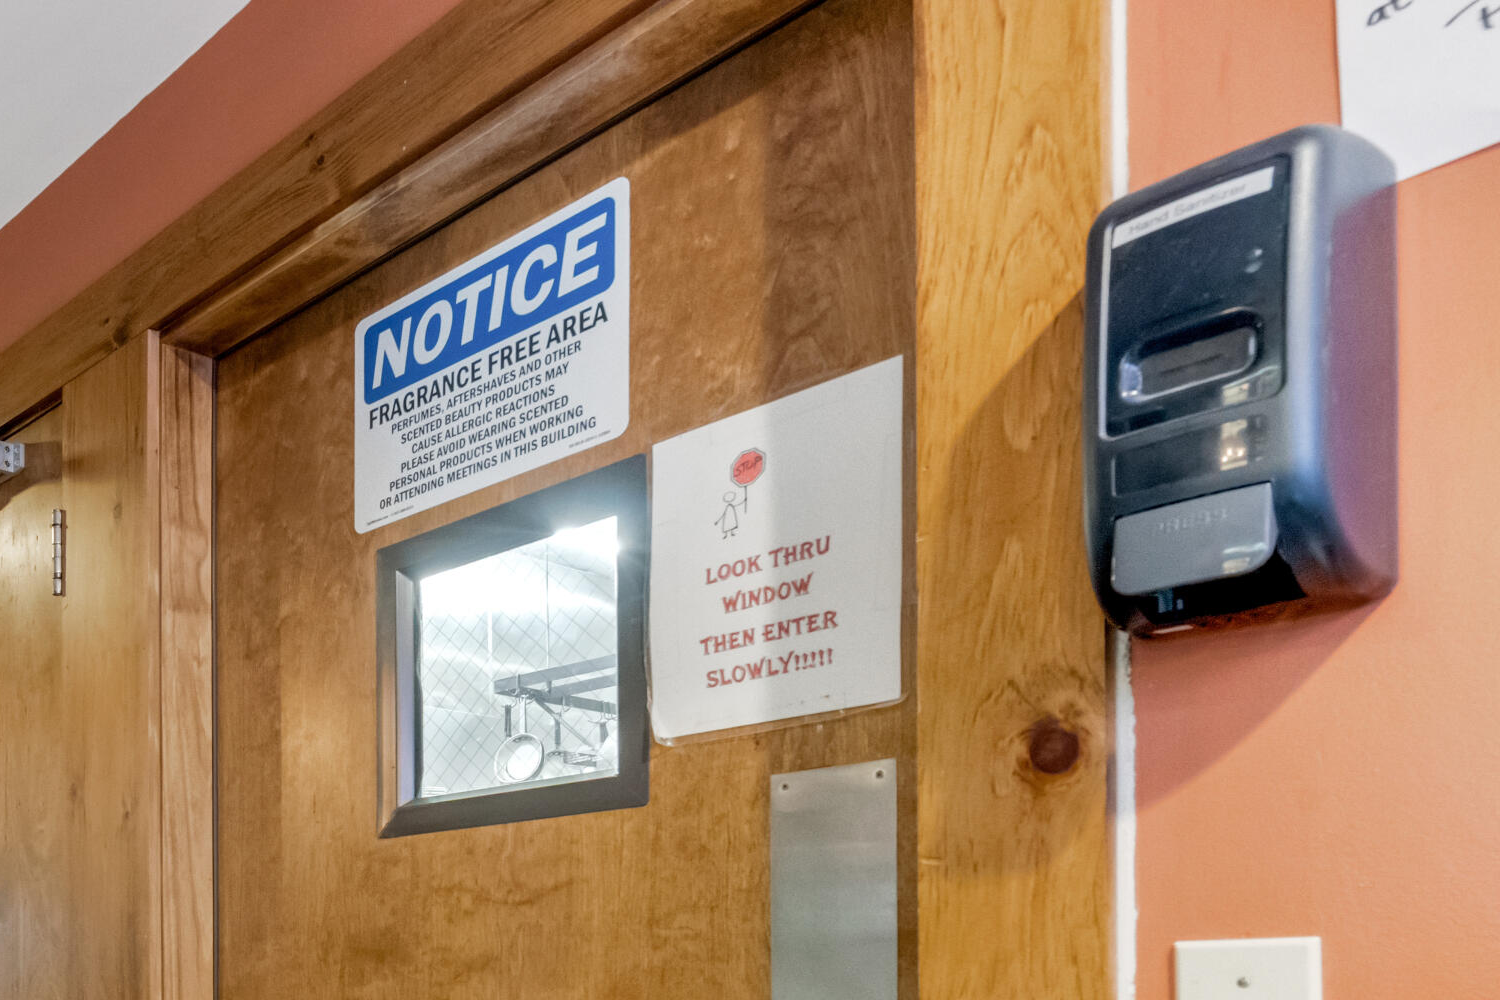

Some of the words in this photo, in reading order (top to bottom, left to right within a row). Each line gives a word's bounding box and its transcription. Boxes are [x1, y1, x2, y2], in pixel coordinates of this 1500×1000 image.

[1129, 211, 1170, 234] Hand
[371, 211, 608, 390] NOTICE
[368, 358, 483, 430] FRAGRANCE
[488, 330, 542, 376] FREE
[545, 300, 609, 350] AREA
[391, 403, 445, 435] PERFUMES,
[446, 369, 517, 411] AFTERSHAVES
[518, 358, 542, 378] AND
[544, 340, 582, 366] OTHER
[400, 418, 443, 445] SCENTED
[444, 399, 483, 426] BEAUTY
[485, 374, 543, 408] PRODUCTS
[544, 360, 570, 382] MAY
[401, 450, 435, 473] PLEASE
[437, 437, 466, 458] AVOID
[468, 417, 517, 445] WEARING
[519, 394, 569, 425] SCENTED
[411, 432, 443, 454] CAUSE
[444, 411, 493, 441] ALLERGIC
[495, 384, 556, 419] REACTIONS
[379, 496, 392, 510] OR
[393, 476, 444, 505] ATTENDING
[446, 455, 498, 484] MEETINGS
[500, 449, 512, 463] IN
[514, 439, 538, 458] THIS
[541, 416, 597, 448] BUILDING
[389, 464, 438, 492] PERSONAL
[439, 441, 493, 472] PRODUCTS
[495, 427, 527, 449] WHEN
[529, 404, 584, 436] WORKING
[733, 455, 764, 478] STOP
[704, 553, 763, 586] LOOK
[768, 535, 831, 566] THRU
[721, 572, 814, 614] WINDOW
[699, 627, 756, 656] THEN
[761, 610, 839, 643] ENTER
[706, 647, 834, 688] SLOWLY!!!!!
